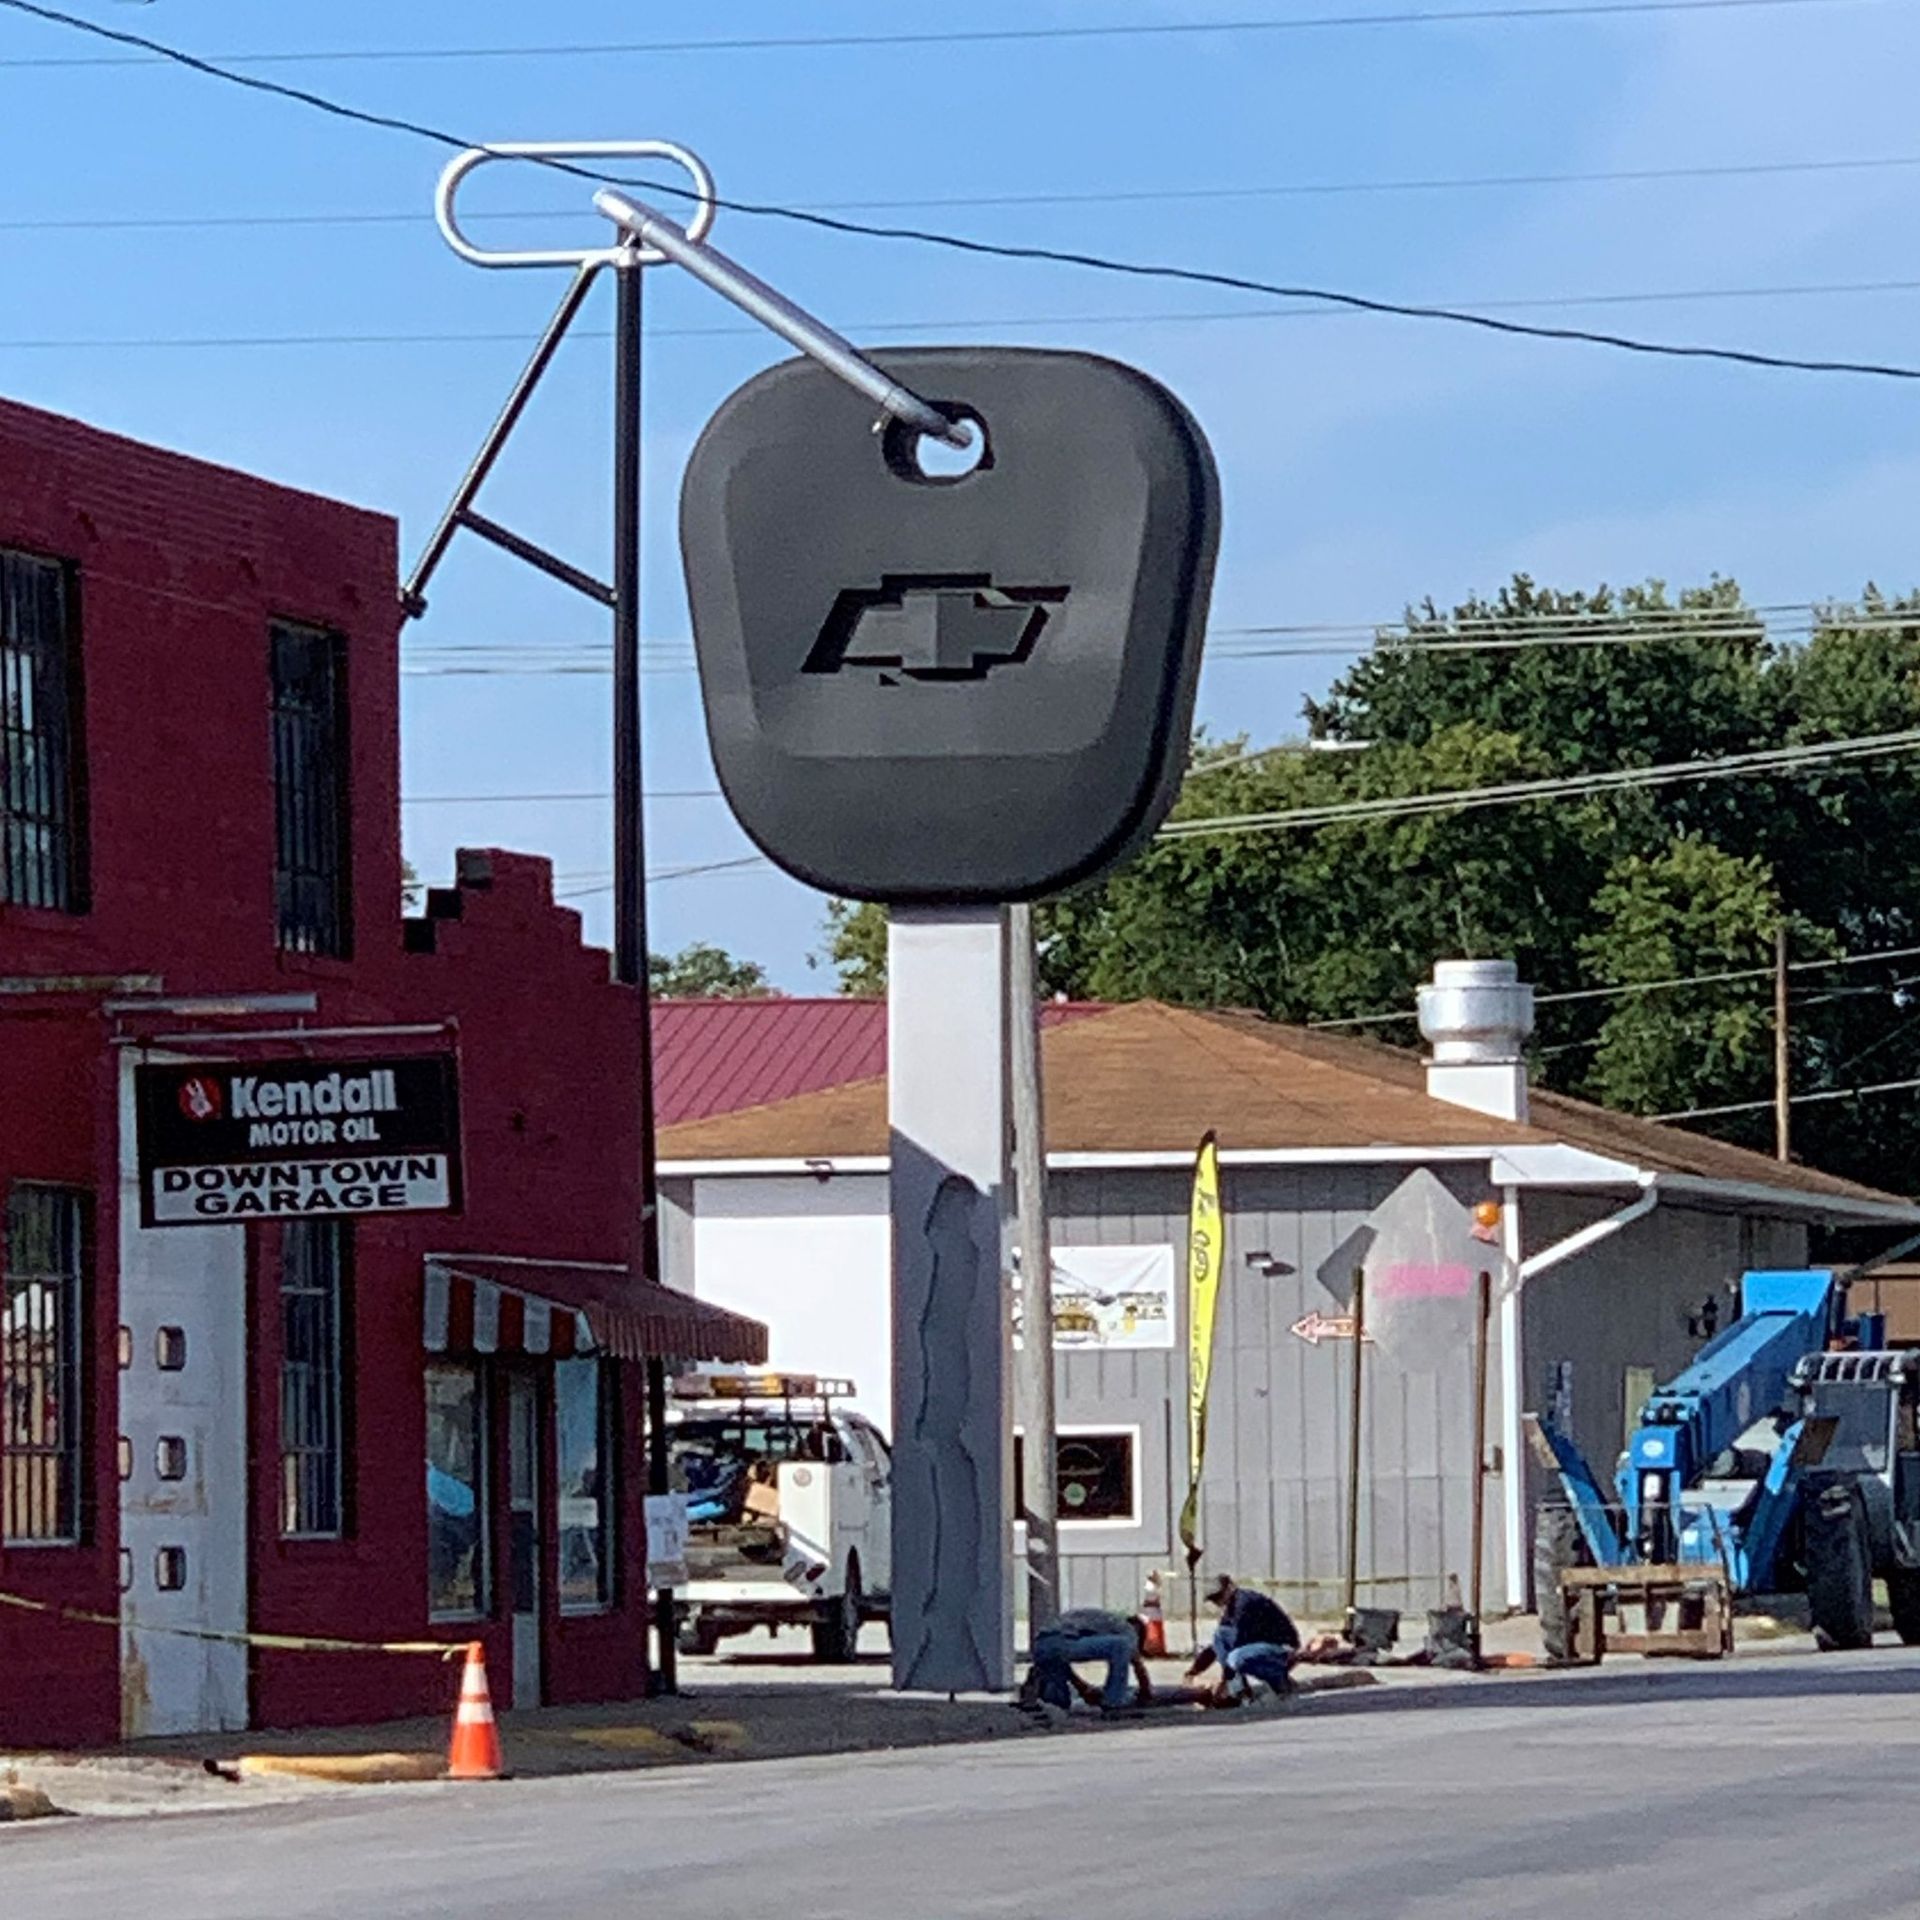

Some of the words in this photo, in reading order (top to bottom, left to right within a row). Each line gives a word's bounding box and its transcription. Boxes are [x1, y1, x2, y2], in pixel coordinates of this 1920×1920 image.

[231, 1070, 397, 1118] Kendall
[249, 1121, 337, 1148] MOTOR
[342, 1118, 380, 1142] OIL
[163, 1158, 437, 1192] DOWNTOWN
[194, 1184, 407, 1215] GARAGE
